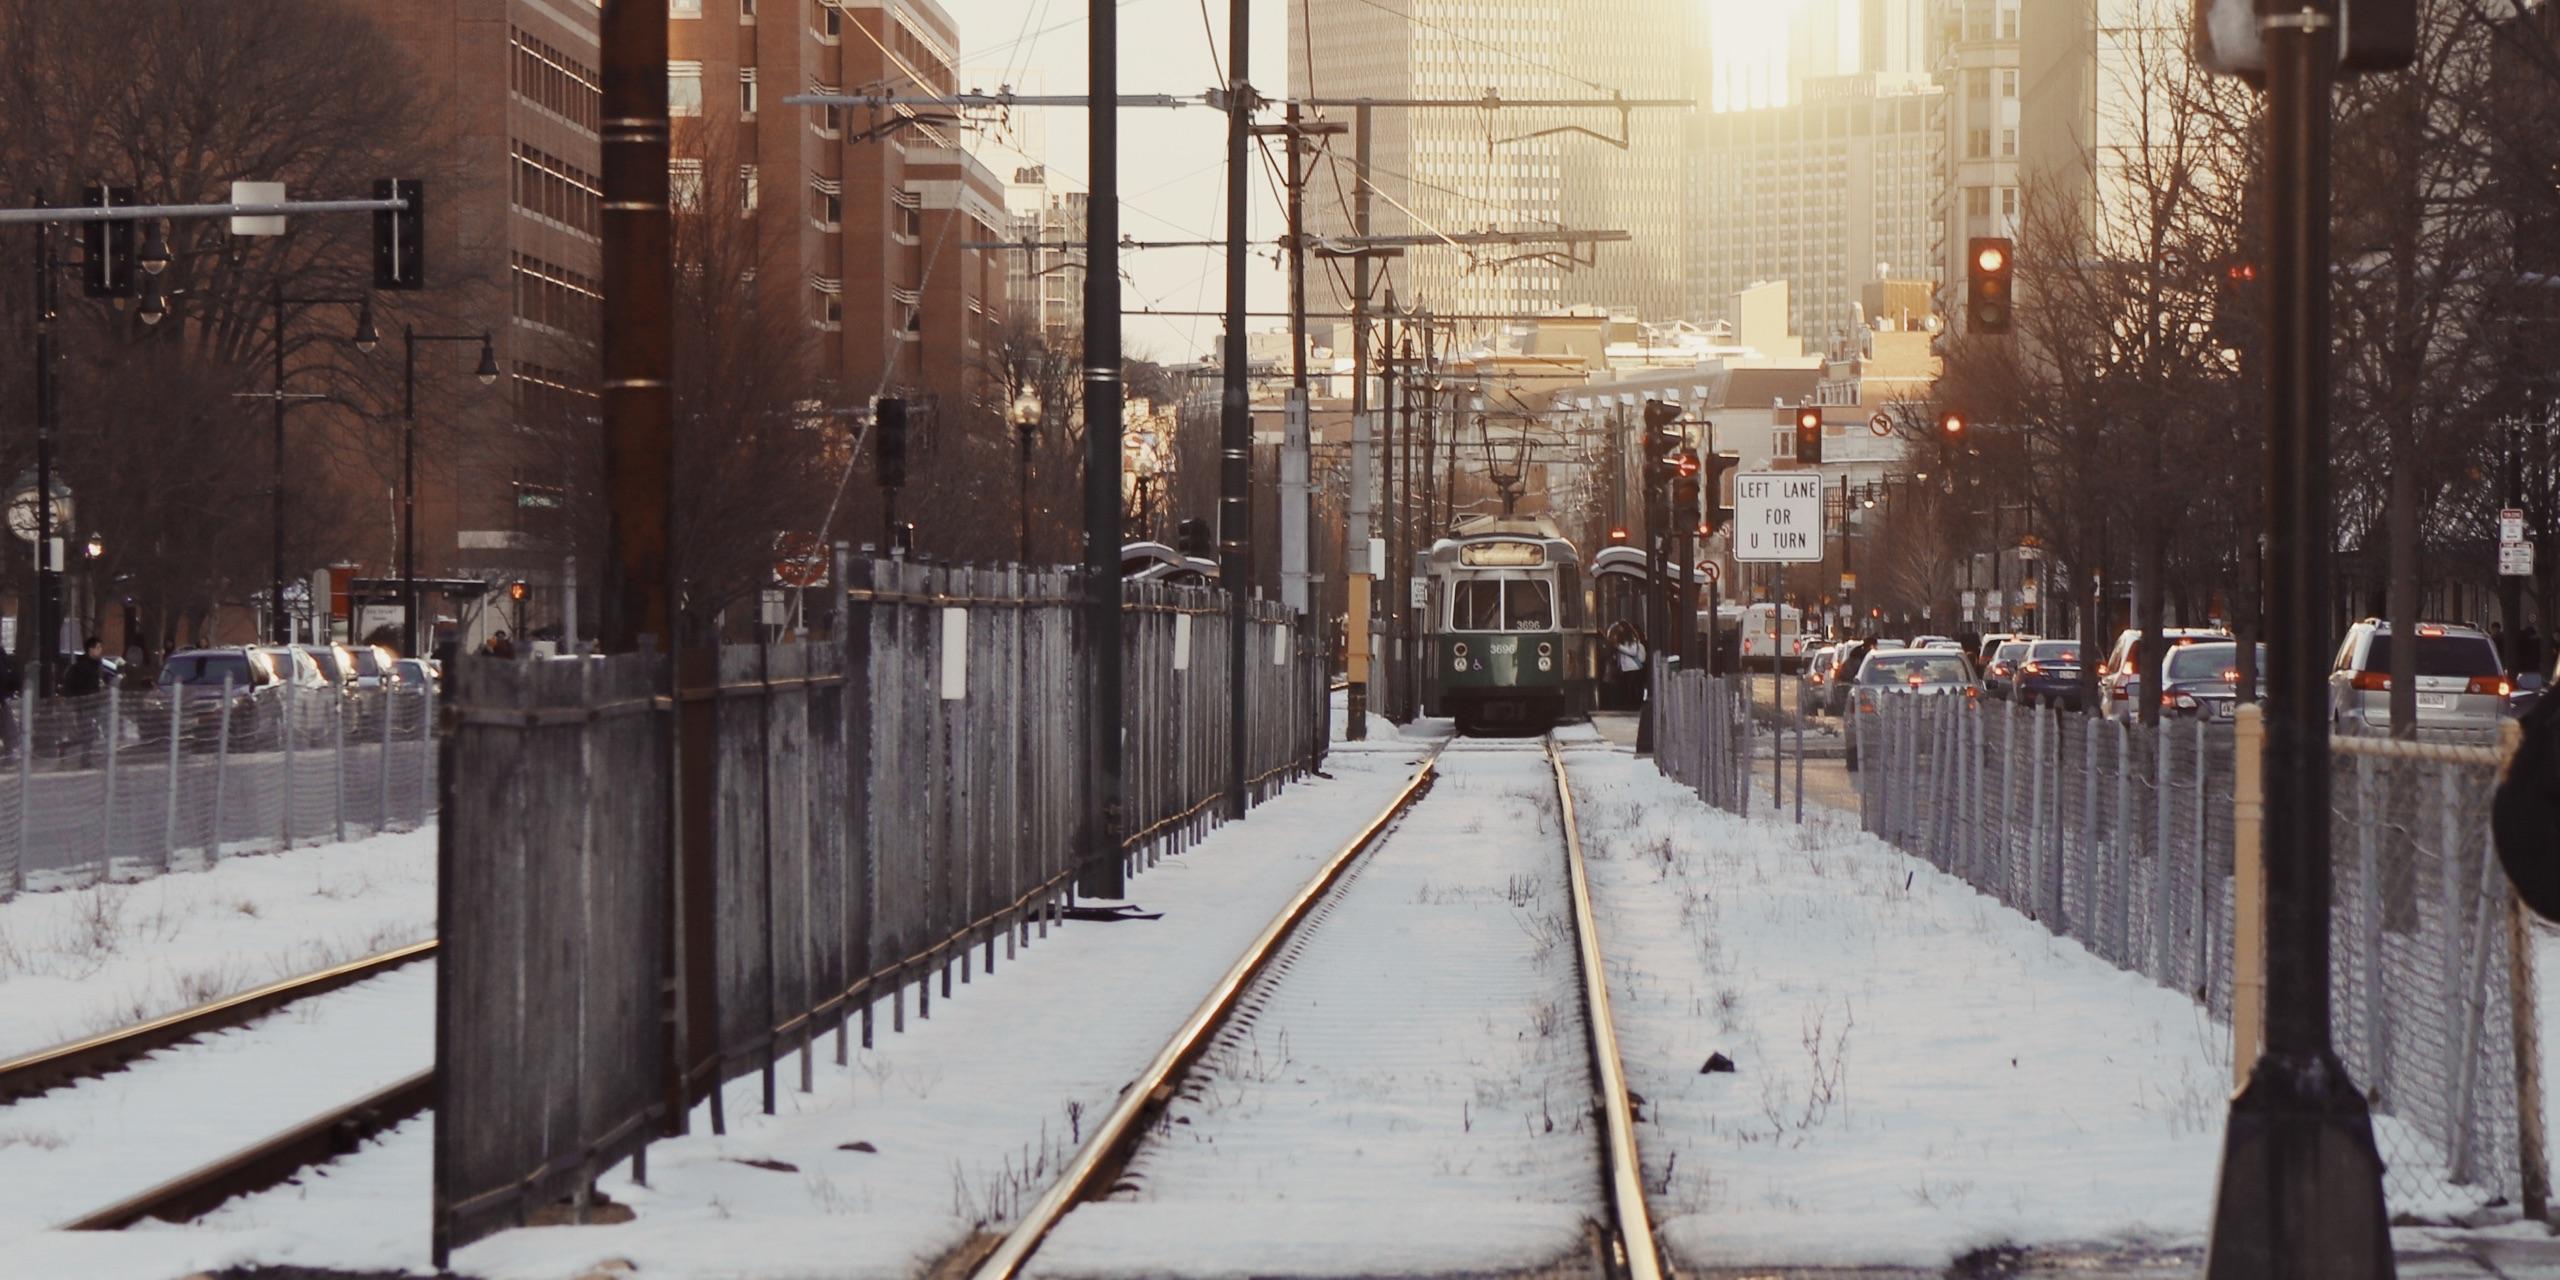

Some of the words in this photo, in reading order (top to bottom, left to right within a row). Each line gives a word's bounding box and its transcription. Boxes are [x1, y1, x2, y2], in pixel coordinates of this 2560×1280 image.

[1740, 482, 1769, 498] LEFT
[1784, 482, 1816, 498] LANE
[1766, 508, 1791, 525] FOR
[1751, 532, 1758, 549] U
[1773, 532, 1806, 549] TURN
[1517, 621, 1540, 630] 3696
[1490, 645, 1515, 654] 3696
